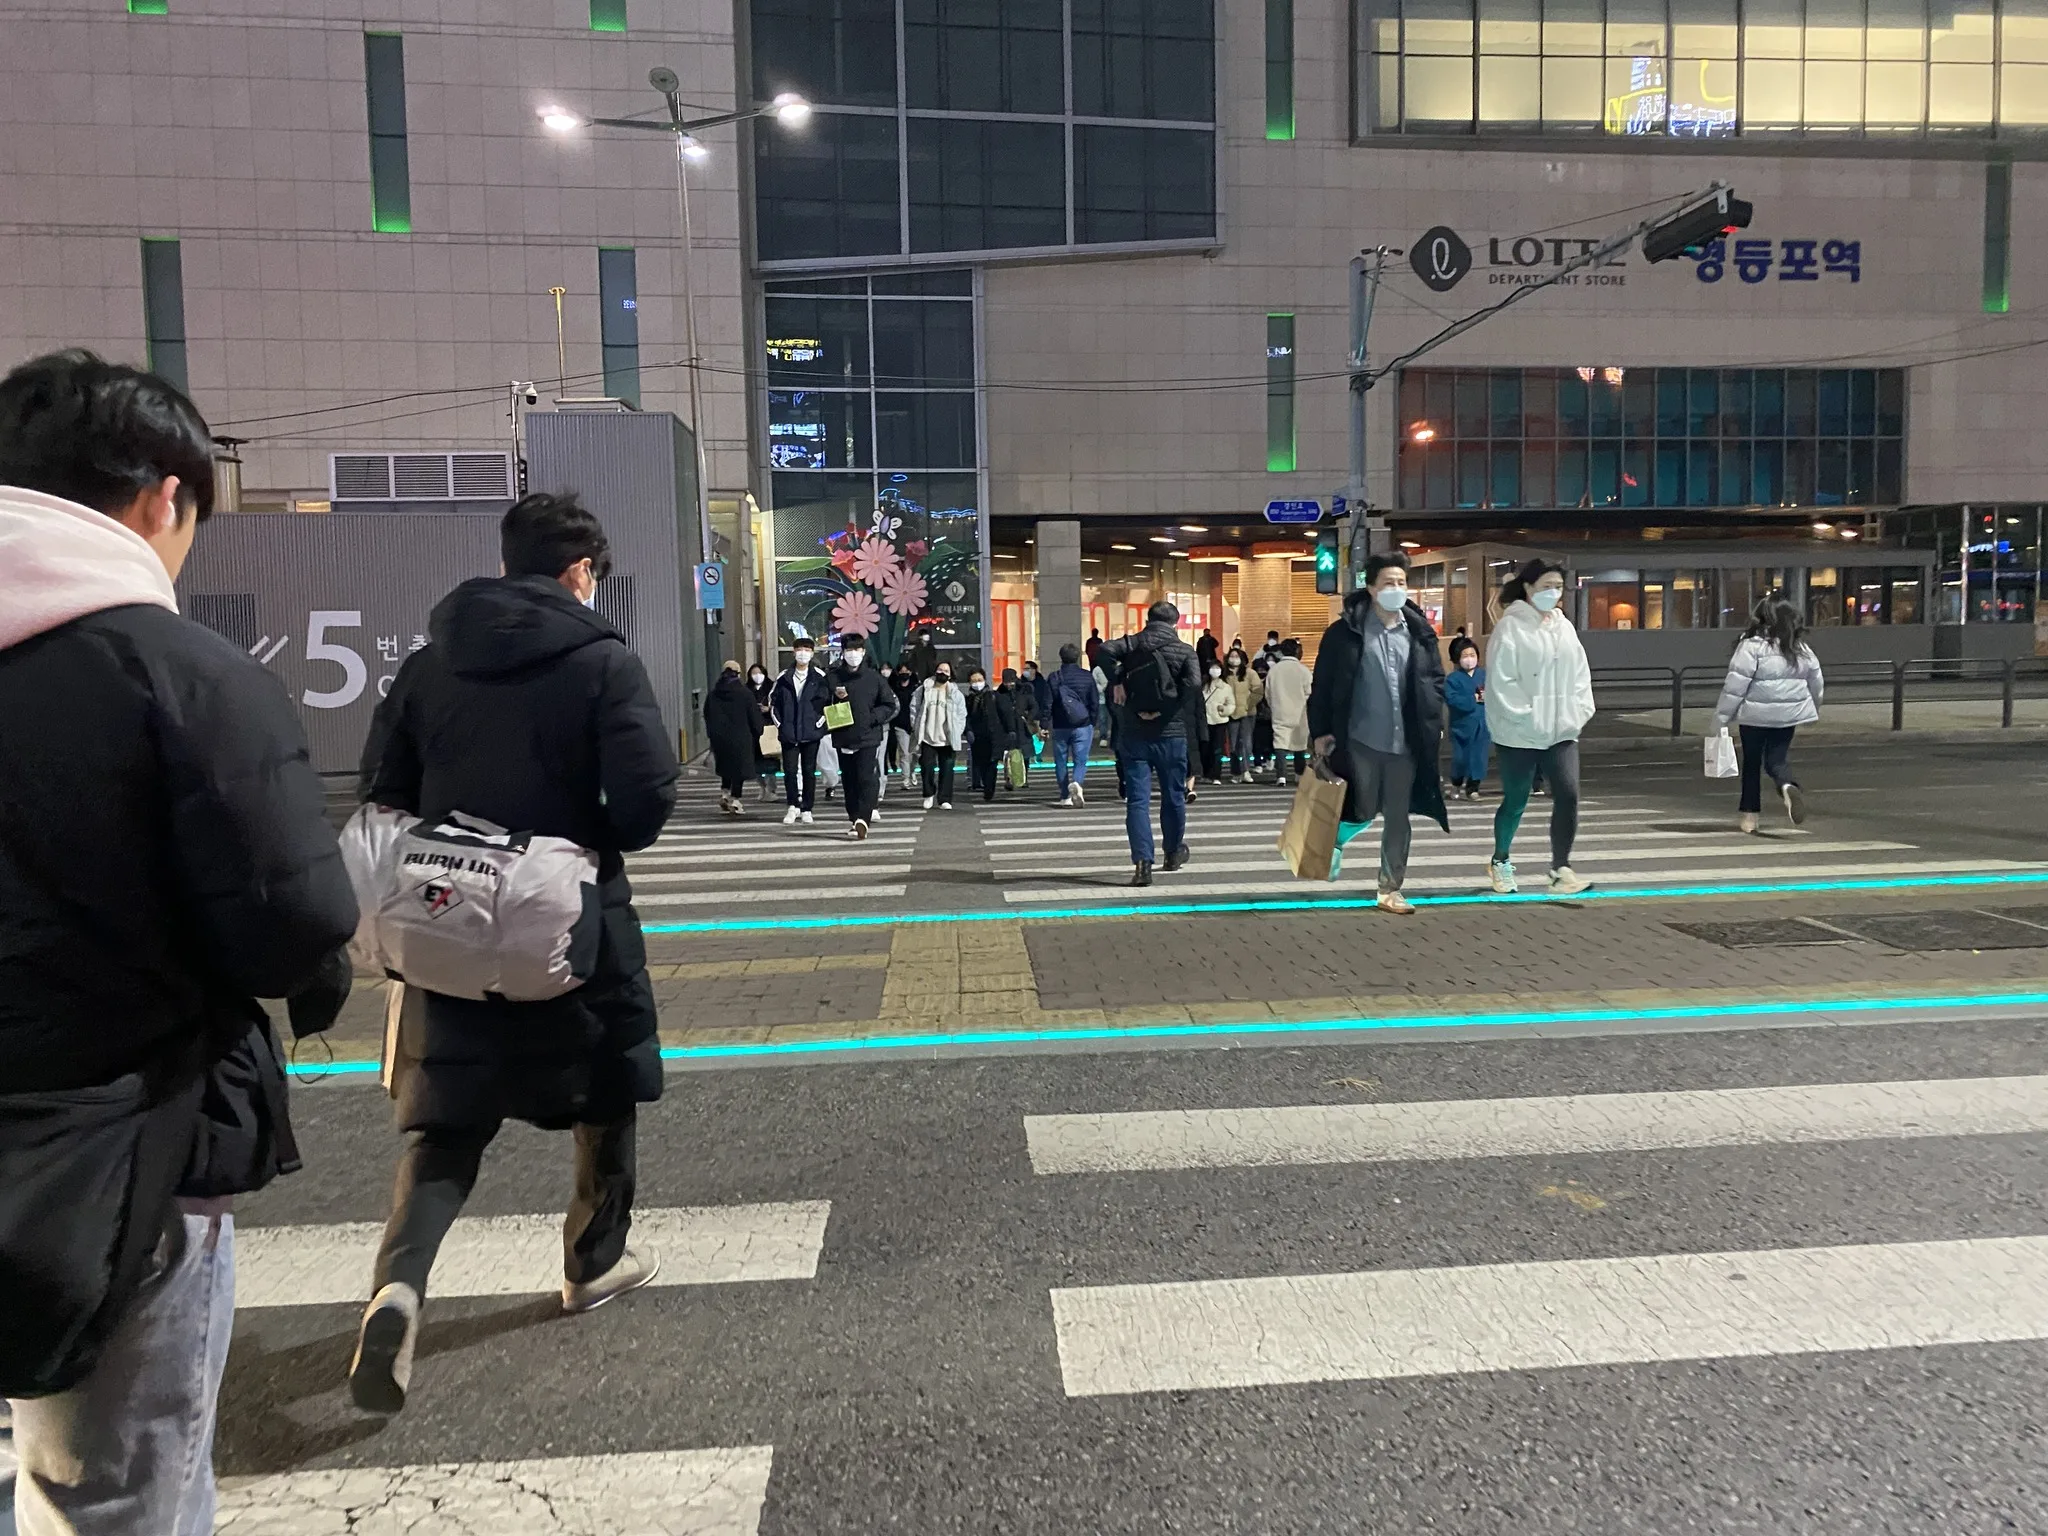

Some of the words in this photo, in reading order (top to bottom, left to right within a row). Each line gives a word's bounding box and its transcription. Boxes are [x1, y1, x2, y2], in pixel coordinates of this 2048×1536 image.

[1489, 237, 1626, 266] LOTT
[1689, 240, 1860, 283] 영등포역
[1489, 274, 1579, 285] DEPARTENT
[1586, 274, 1626, 285] STORE
[303, 611, 367, 709] 5
[403, 852, 464, 871] BURN
